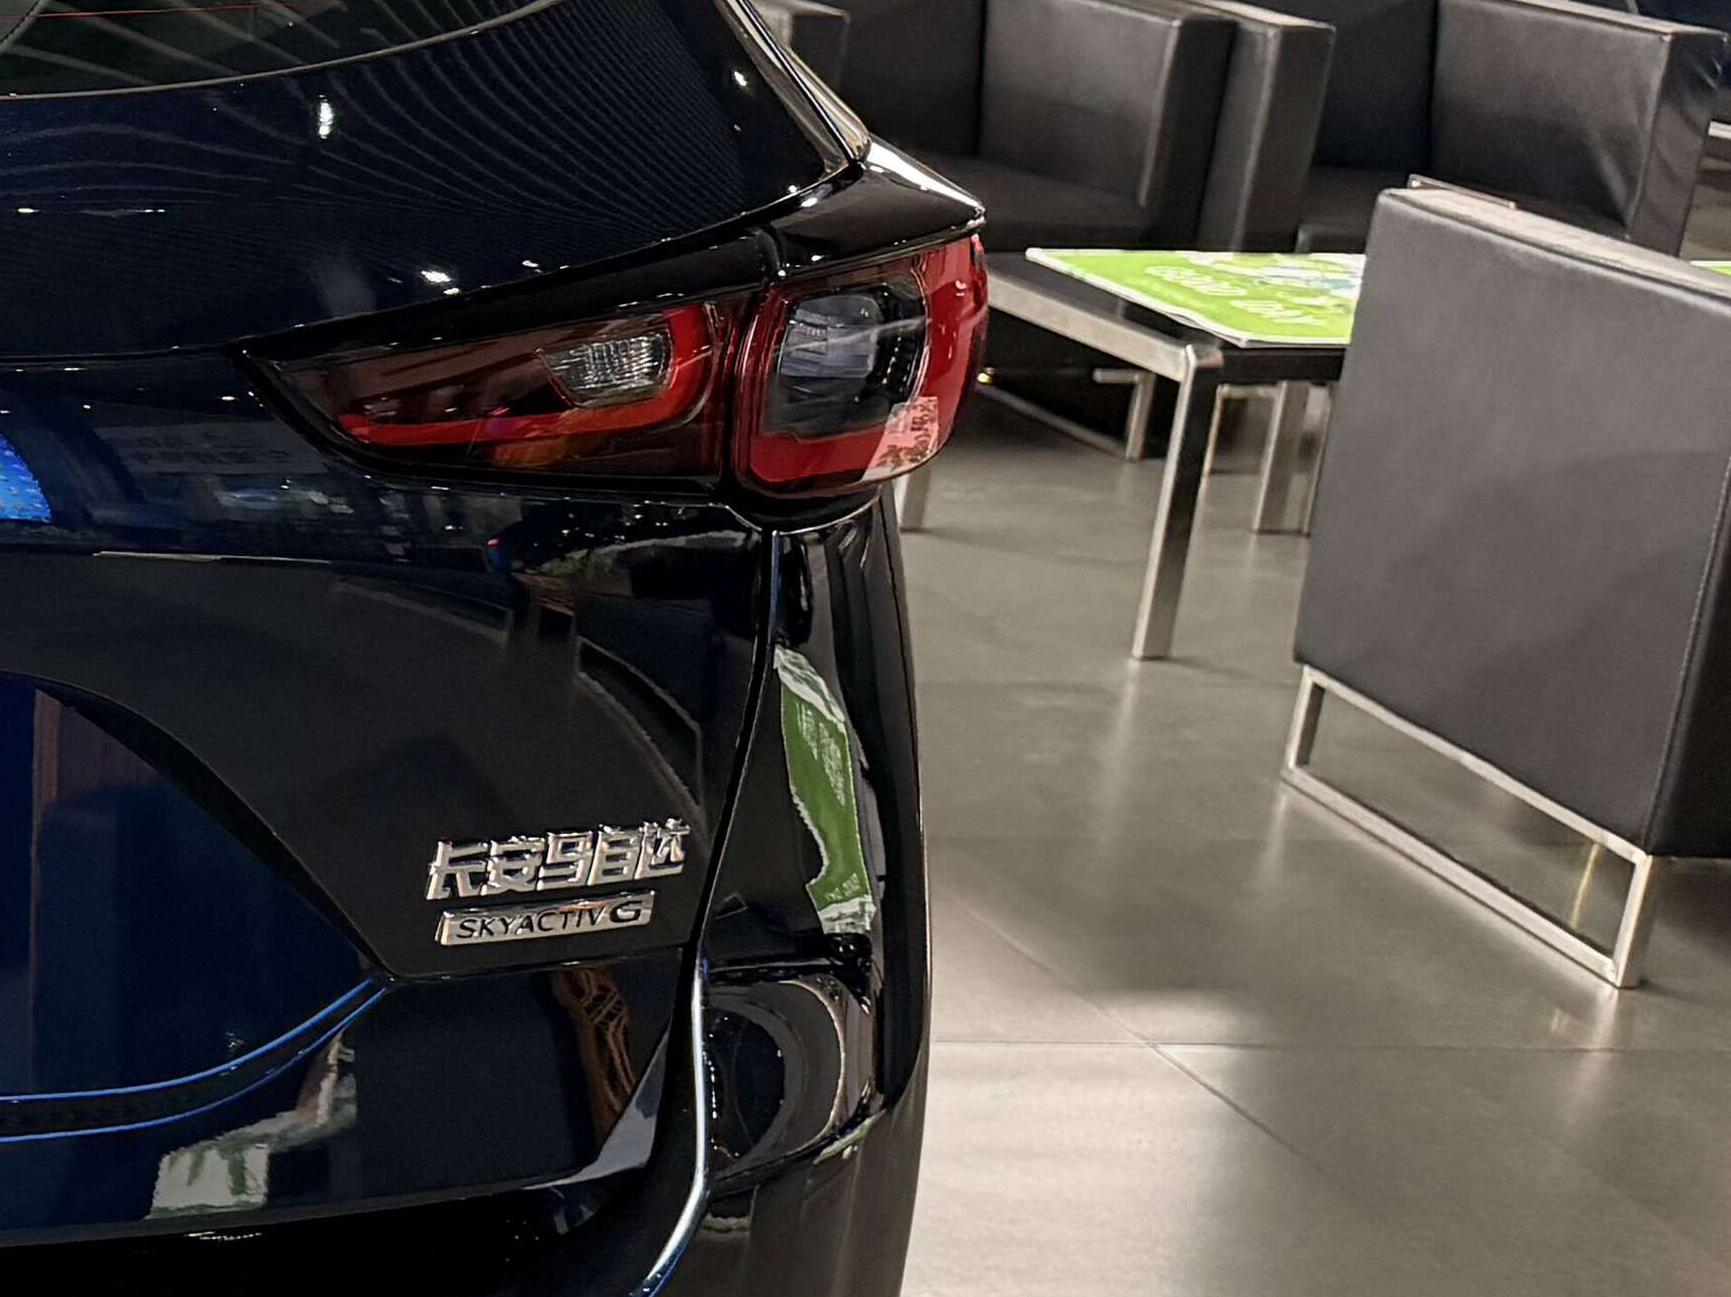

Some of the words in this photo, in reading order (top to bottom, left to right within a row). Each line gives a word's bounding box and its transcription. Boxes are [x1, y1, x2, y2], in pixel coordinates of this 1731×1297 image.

[426, 817, 690, 900] 长安马自达
